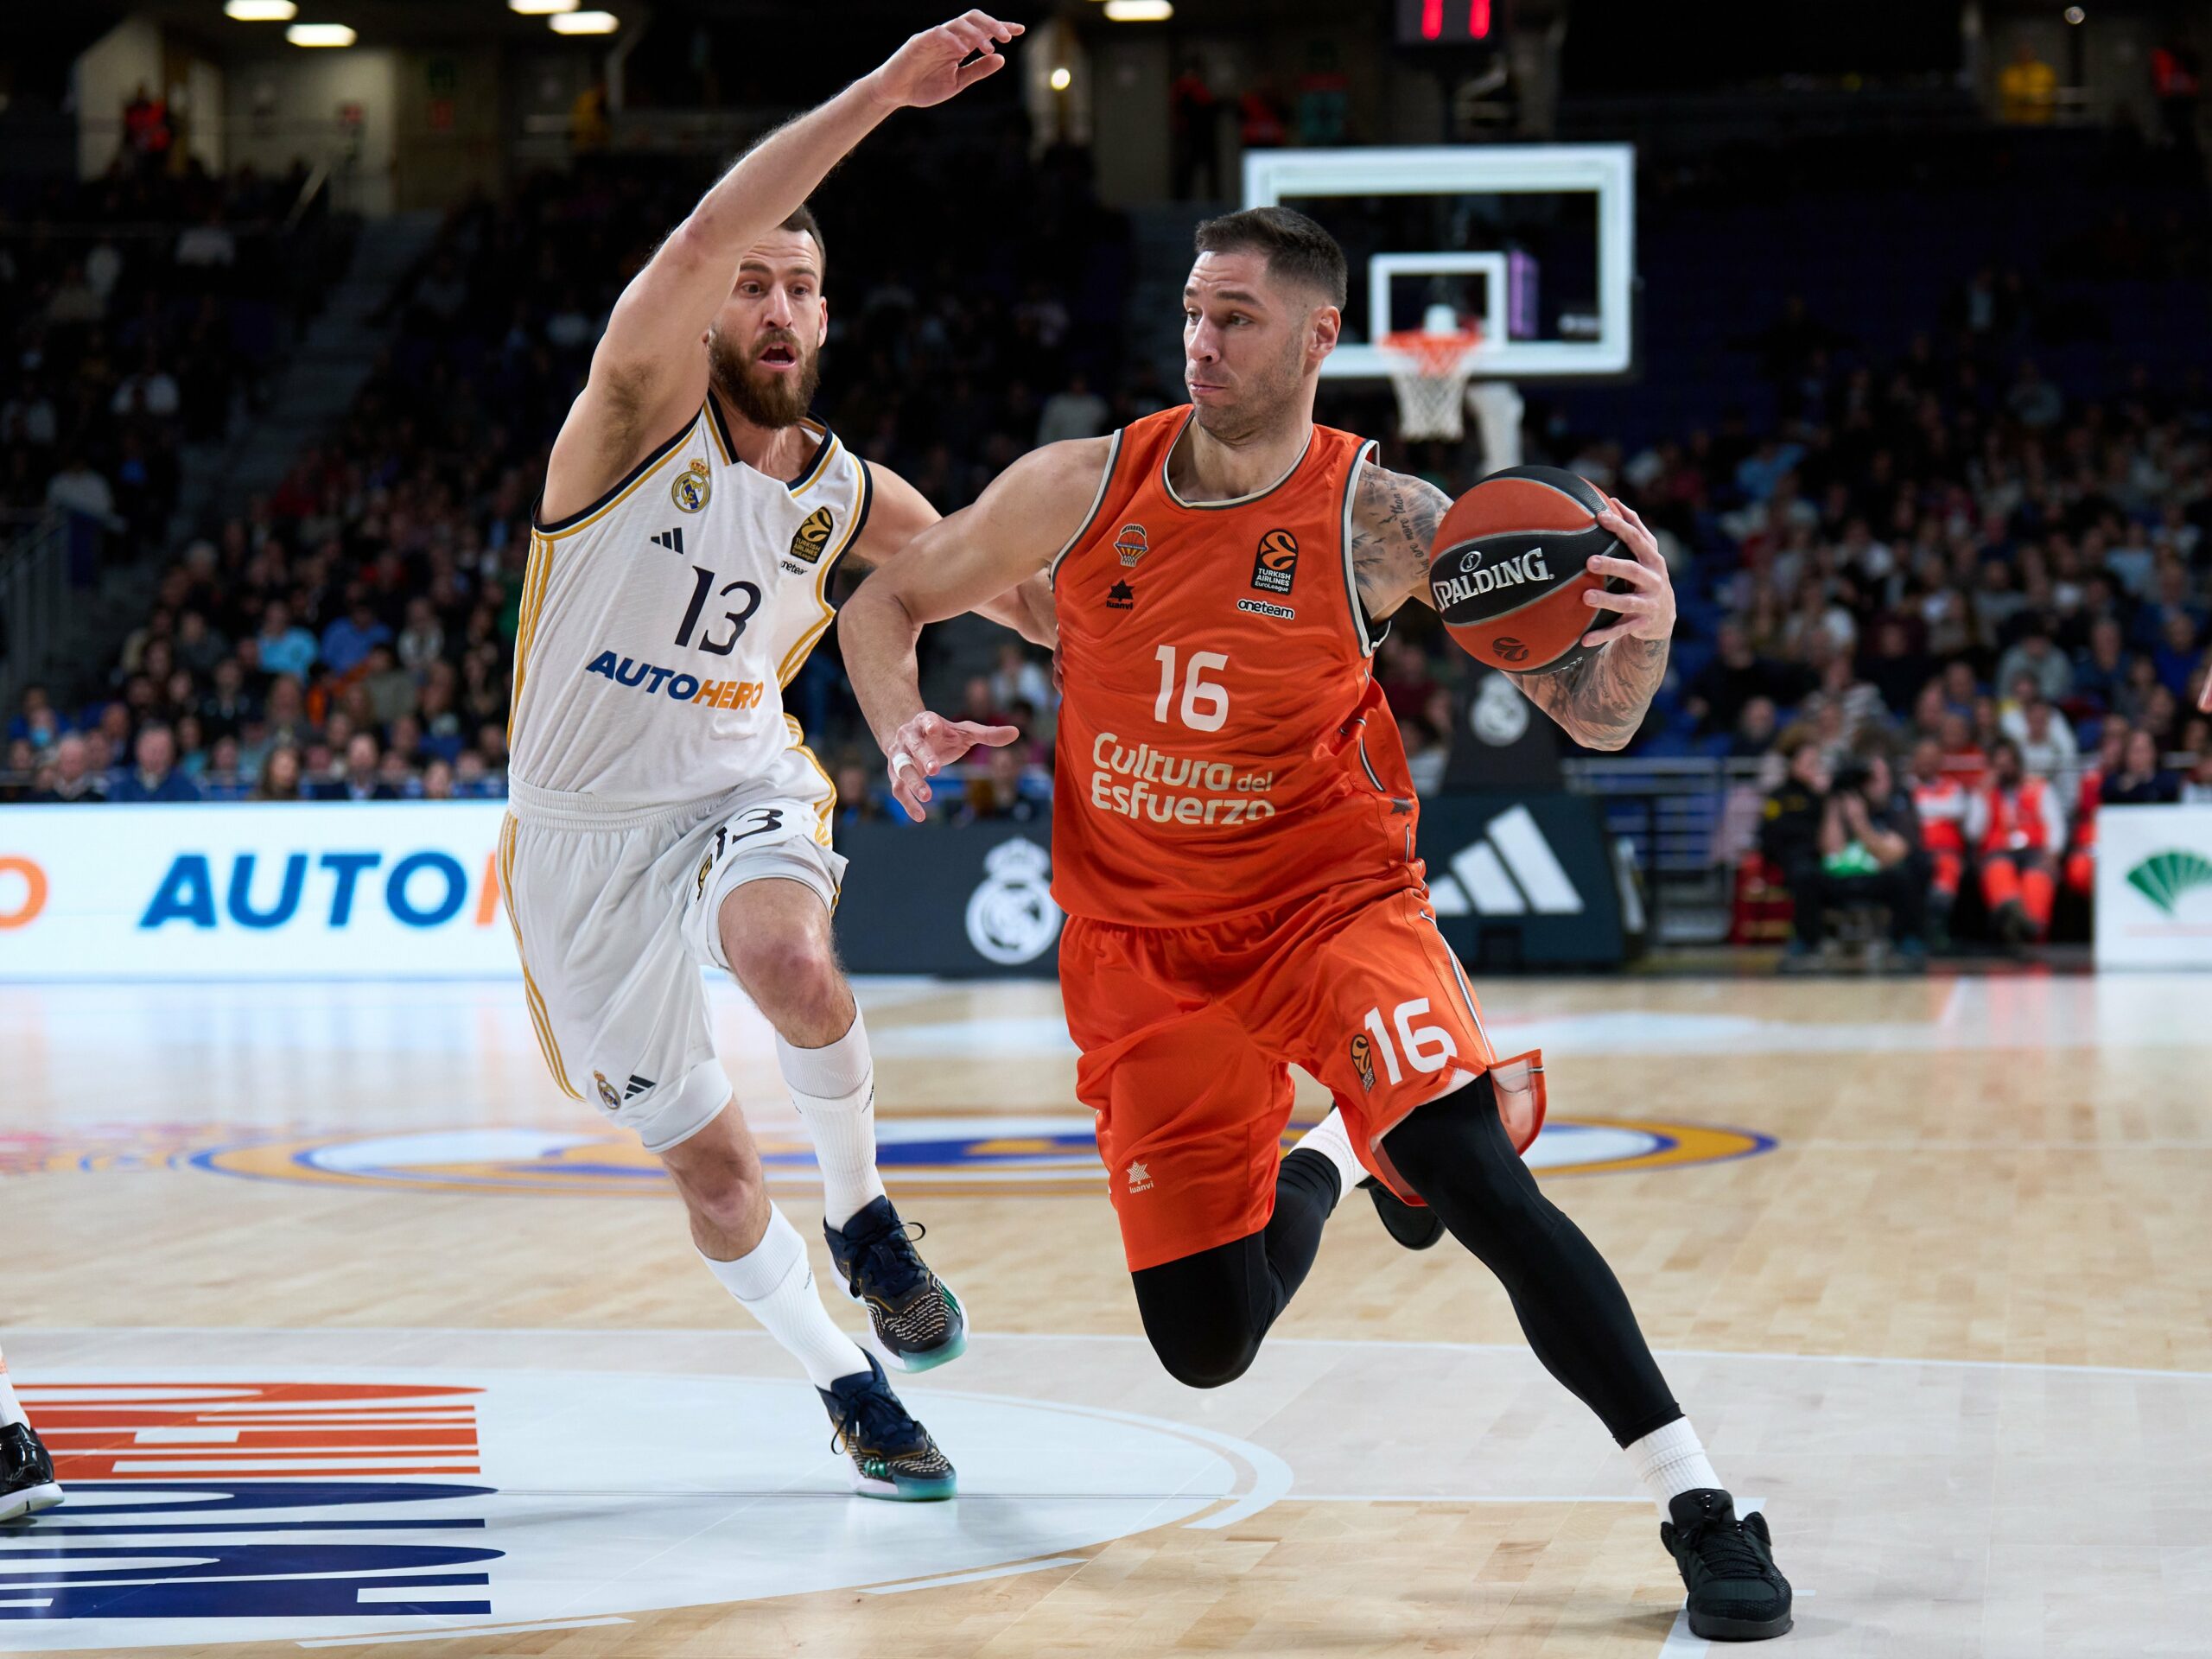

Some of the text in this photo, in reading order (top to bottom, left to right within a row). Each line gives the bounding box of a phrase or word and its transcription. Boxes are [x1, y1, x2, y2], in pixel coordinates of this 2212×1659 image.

[1256, 575, 1290, 587] AIRLINES
[1257, 568, 1291, 580] TURKISH
[1433, 547, 1549, 613] SPALDING
[674, 565, 762, 656] 13
[1238, 600, 1294, 619] oneteam
[586, 650, 764, 710] AUTOHERO
[1154, 645, 1229, 732] 16
[1093, 732, 1274, 792] Cultura del
[1091, 771, 1276, 825] Esfuerzo
[716, 809, 784, 862] 13
[1363, 997, 1458, 1085] 16
[1129, 1180, 1154, 1194] luanvi
